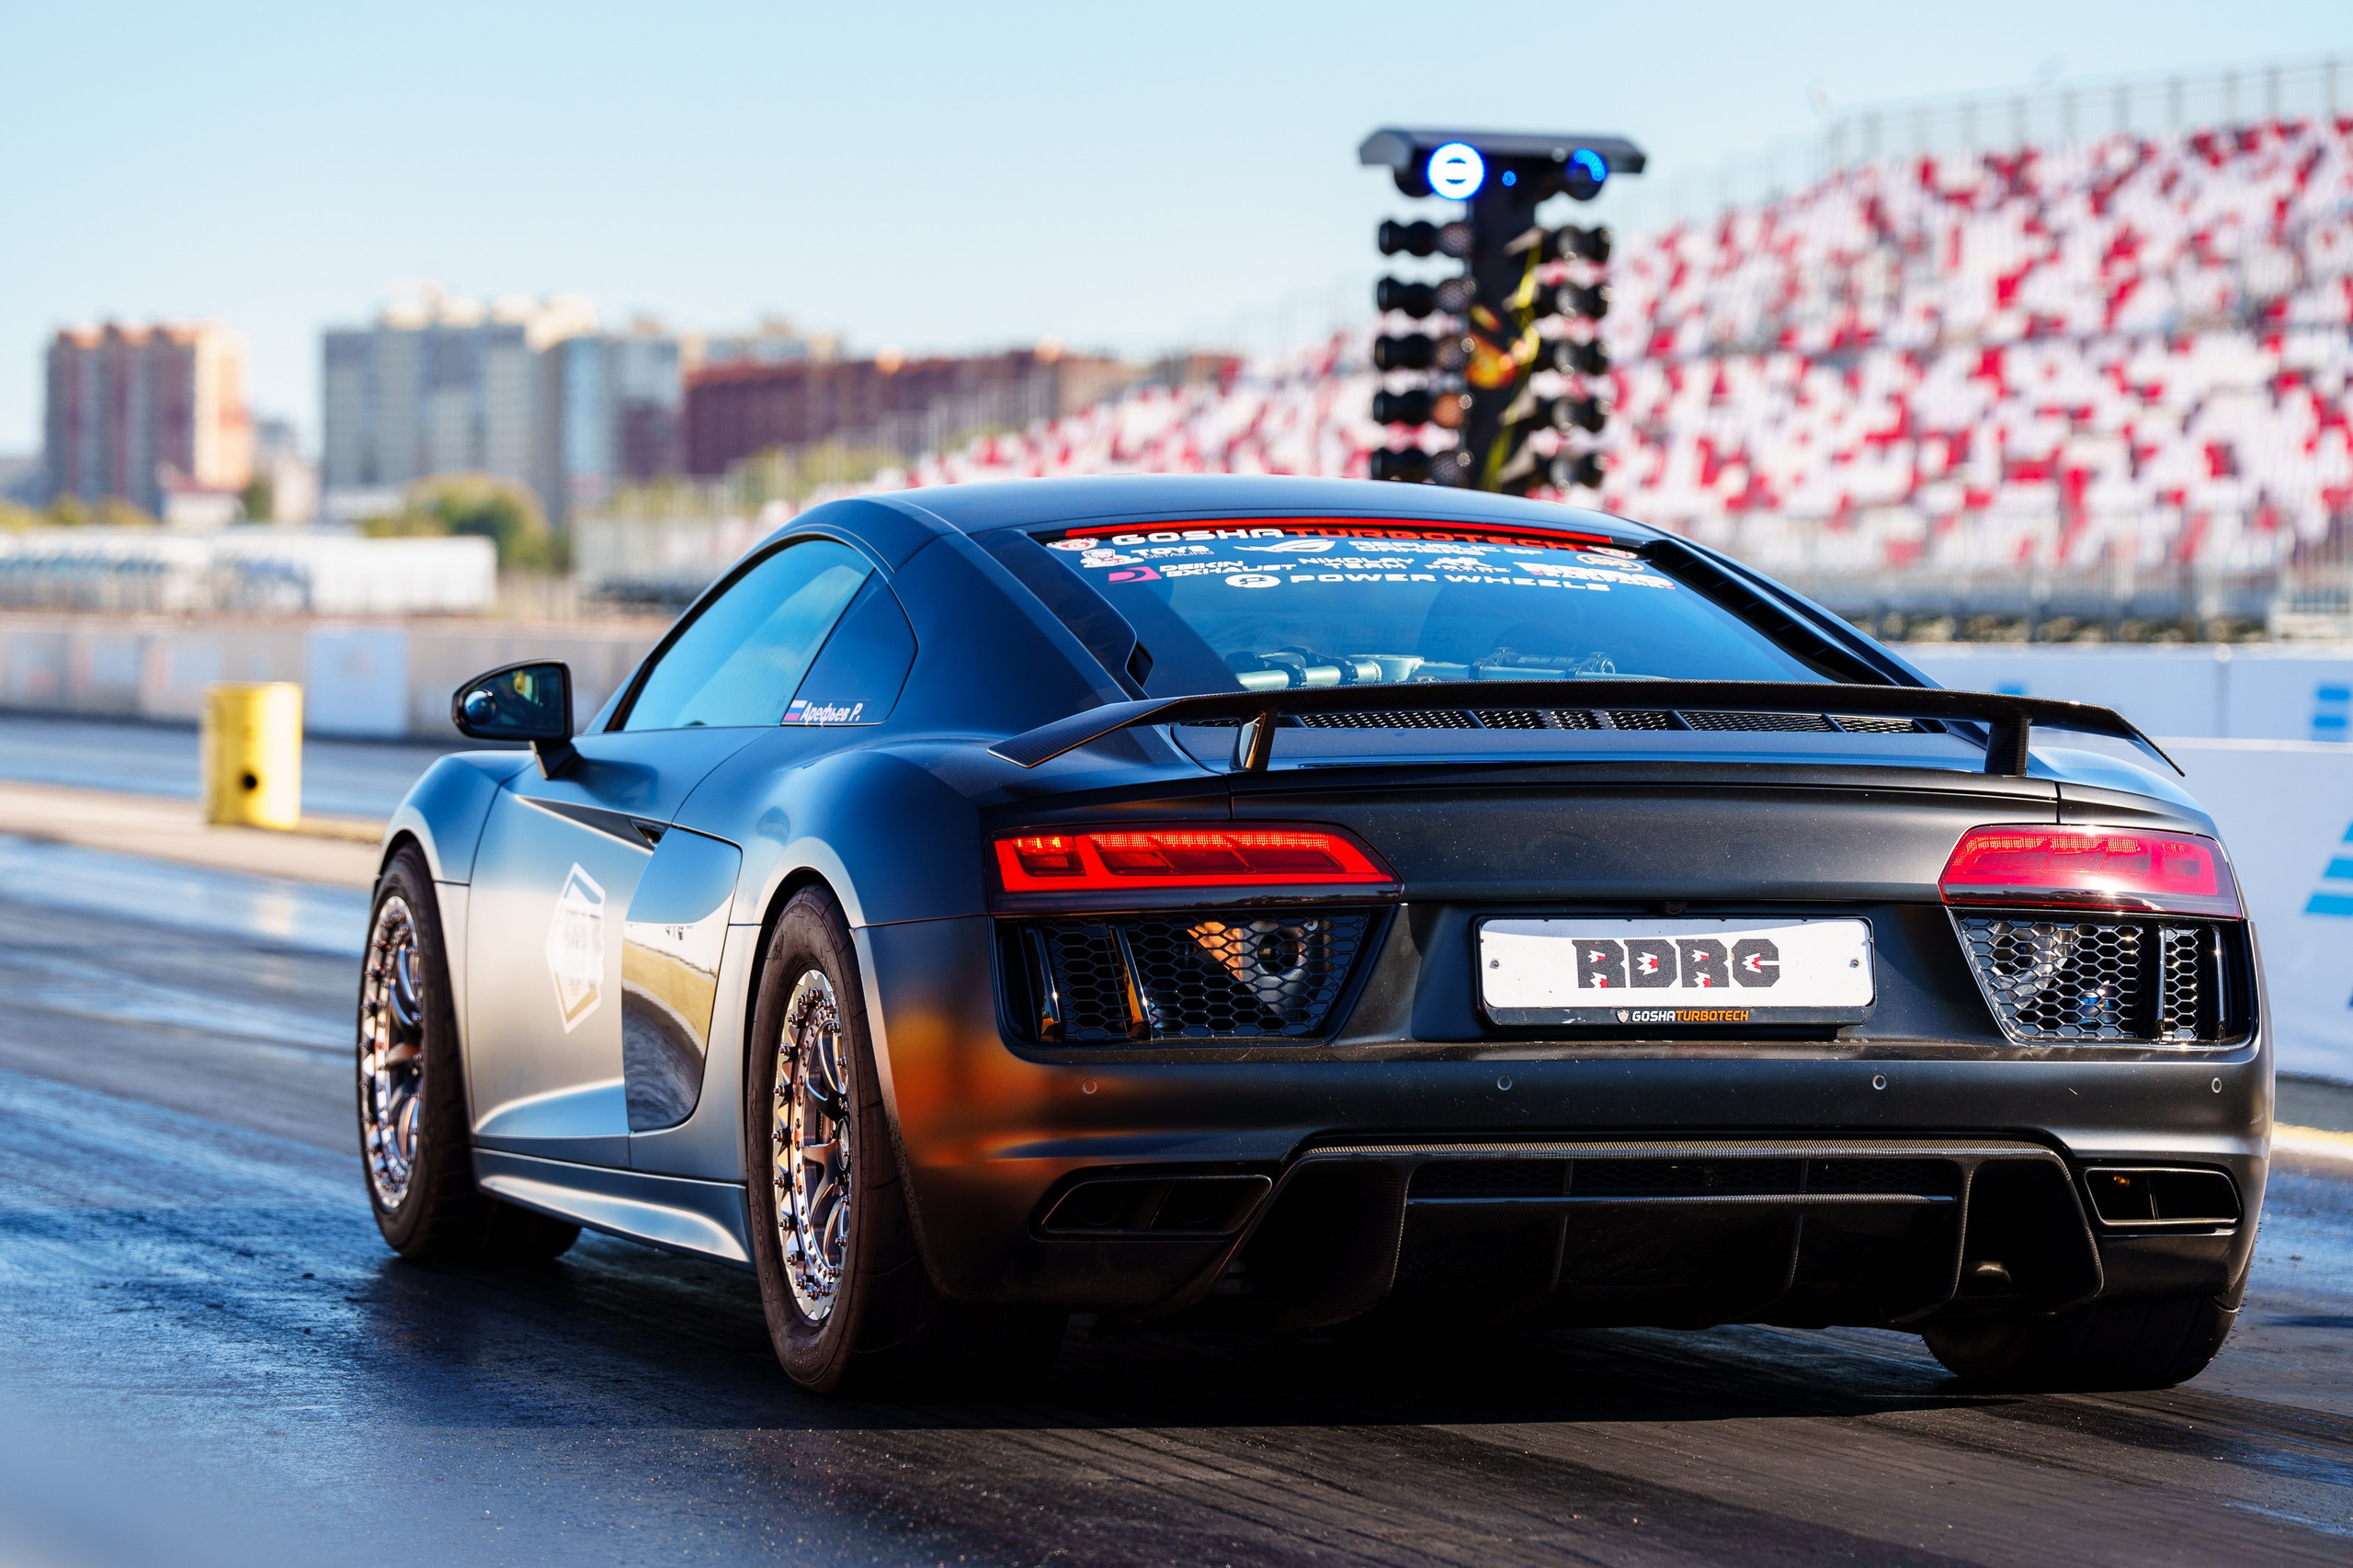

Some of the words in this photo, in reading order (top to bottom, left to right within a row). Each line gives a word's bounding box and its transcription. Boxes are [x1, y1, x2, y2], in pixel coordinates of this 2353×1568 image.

[1131, 545, 1211, 556] TOYS
[1166, 563, 1297, 577] EXHAUST
[1290, 573, 1437, 584] POWER
[1444, 574, 1610, 591] WHEELS
[799, 701, 851, 726] Арефьев
[1572, 938, 1780, 988] RDRC
